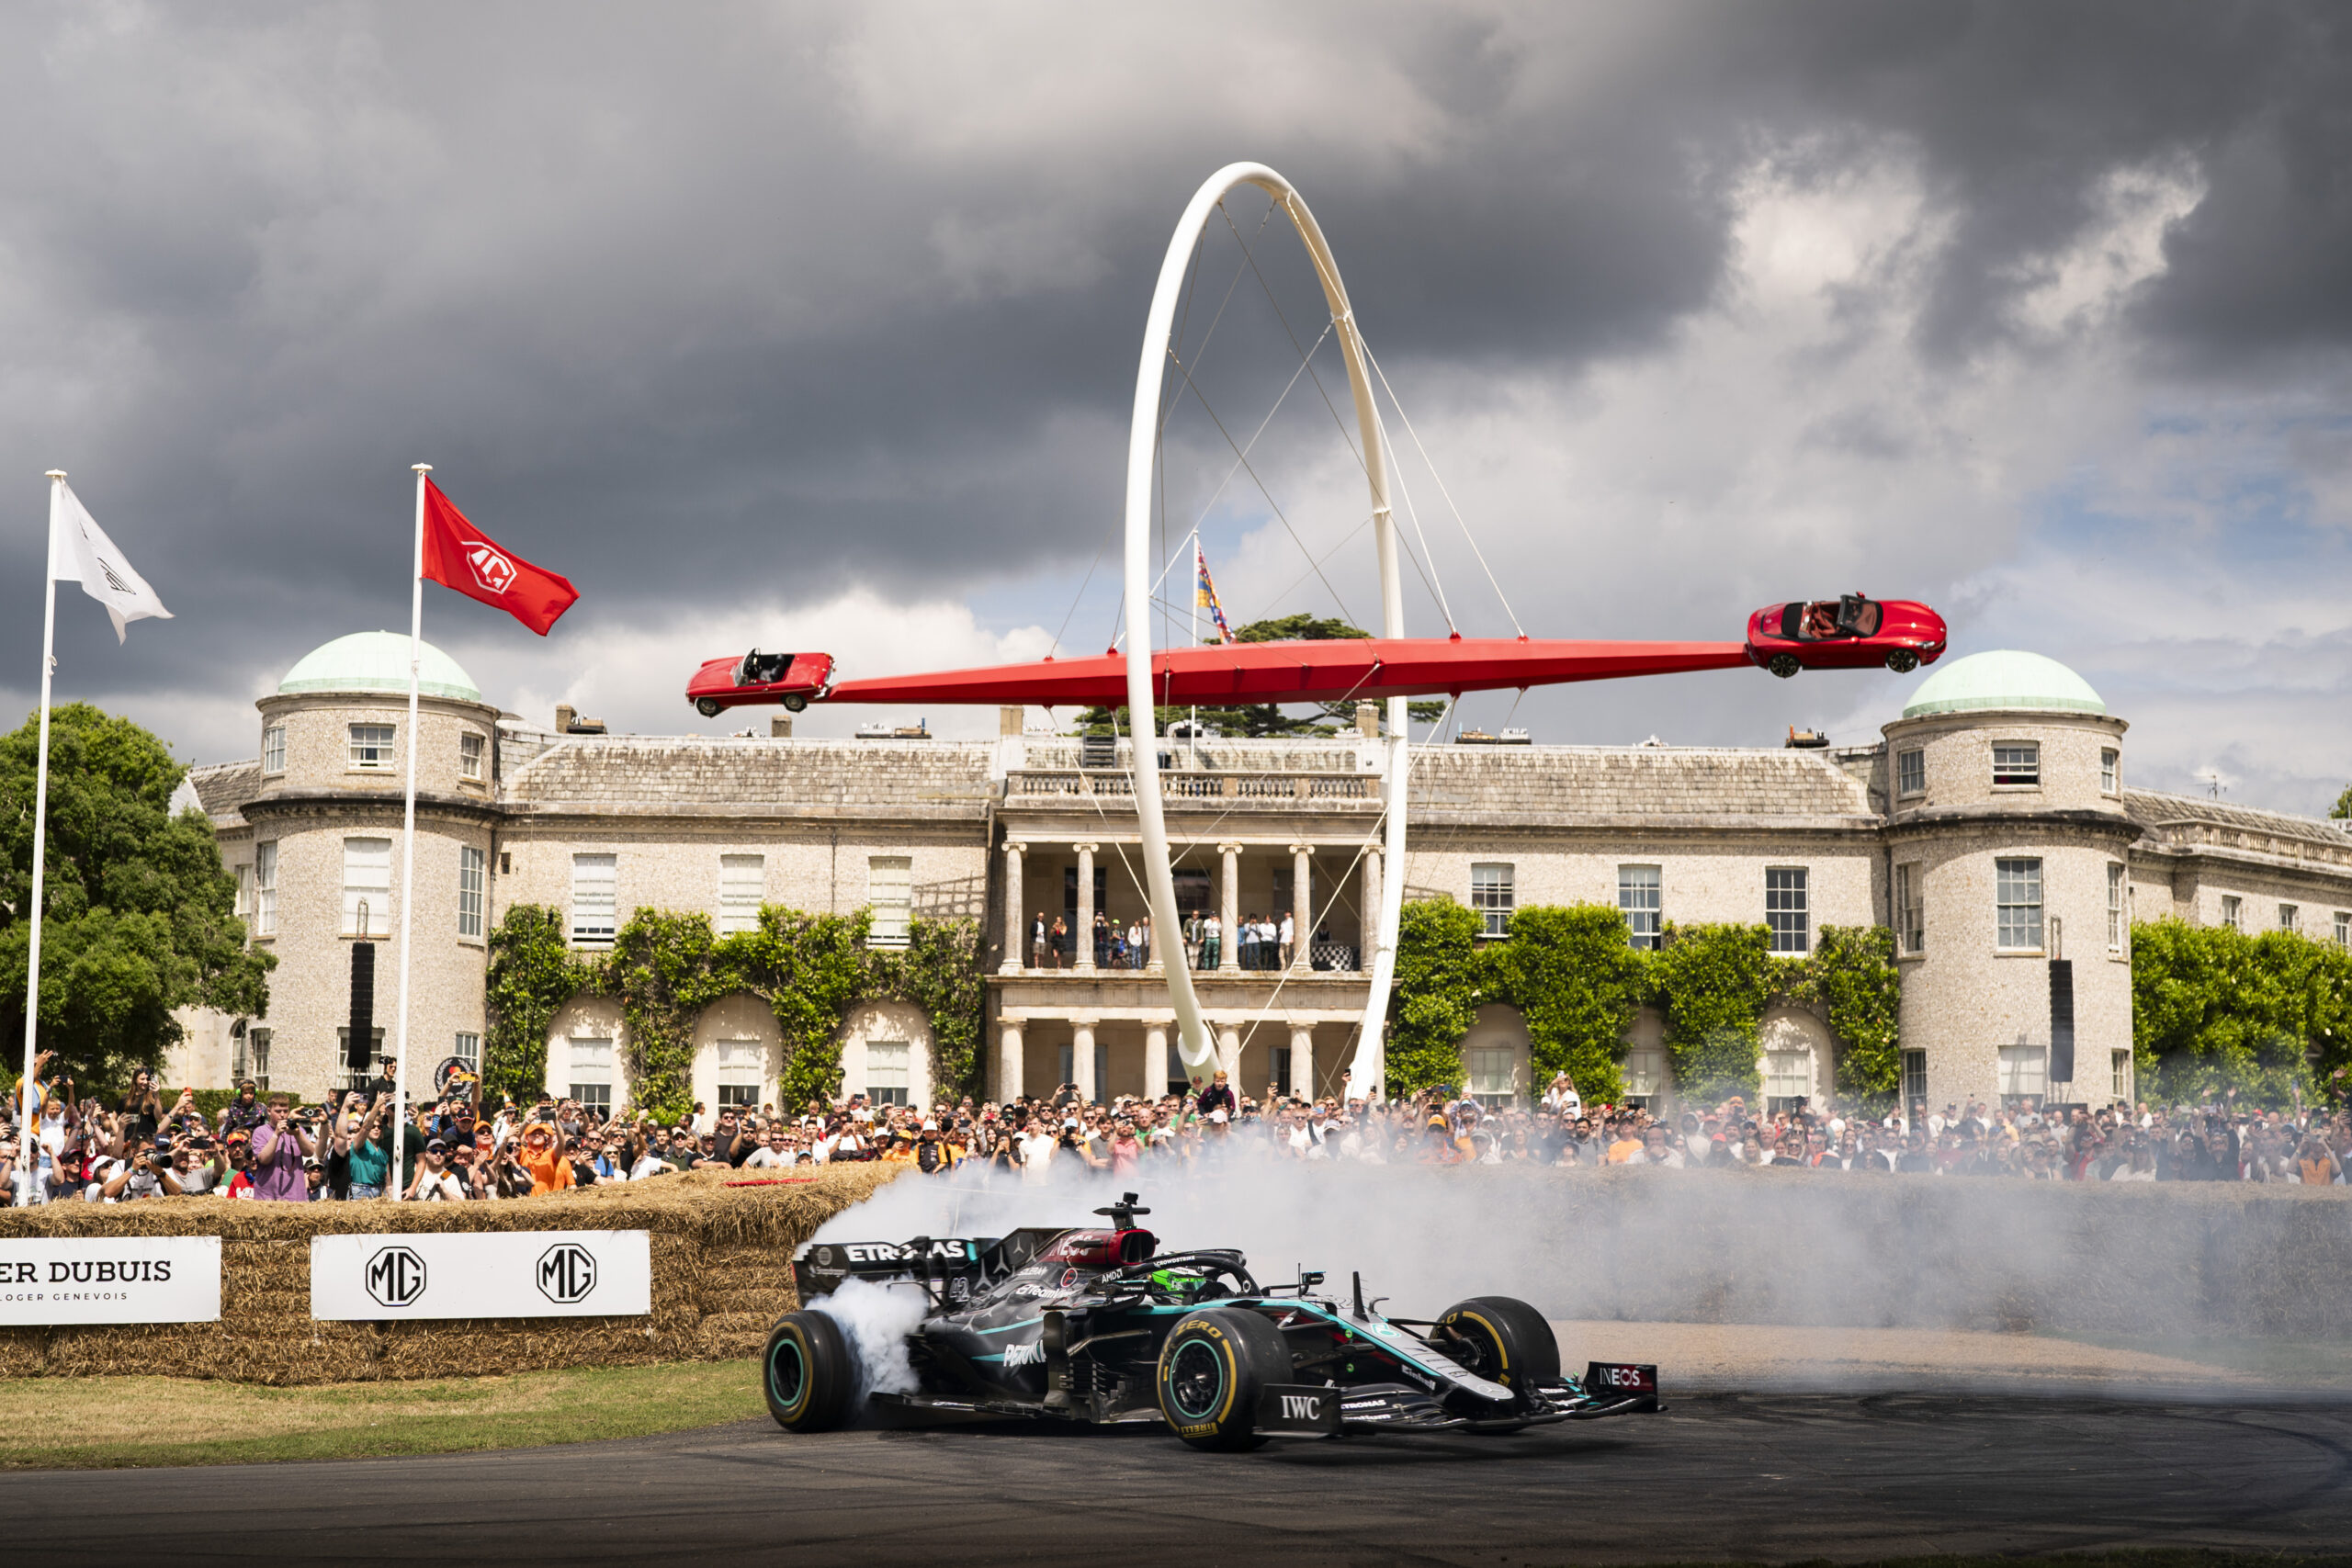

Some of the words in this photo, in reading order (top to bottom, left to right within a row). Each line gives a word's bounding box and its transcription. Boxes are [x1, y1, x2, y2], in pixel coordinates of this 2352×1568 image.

[49, 1260, 171, 1282] DUBUIS
[371, 1252, 421, 1302] MG
[542, 1249, 592, 1298] MG
[1102, 1272, 1117, 1285] AMD
[0, 1293, 44, 1302] OGER
[53, 1292, 128, 1301] GENEVOIS
[1175, 1320, 1223, 1338] ZERO
[1600, 1367, 1640, 1386] INEOS
[1281, 1395, 1320, 1420] IWC
[1181, 1422, 1218, 1438] PIRELLI
